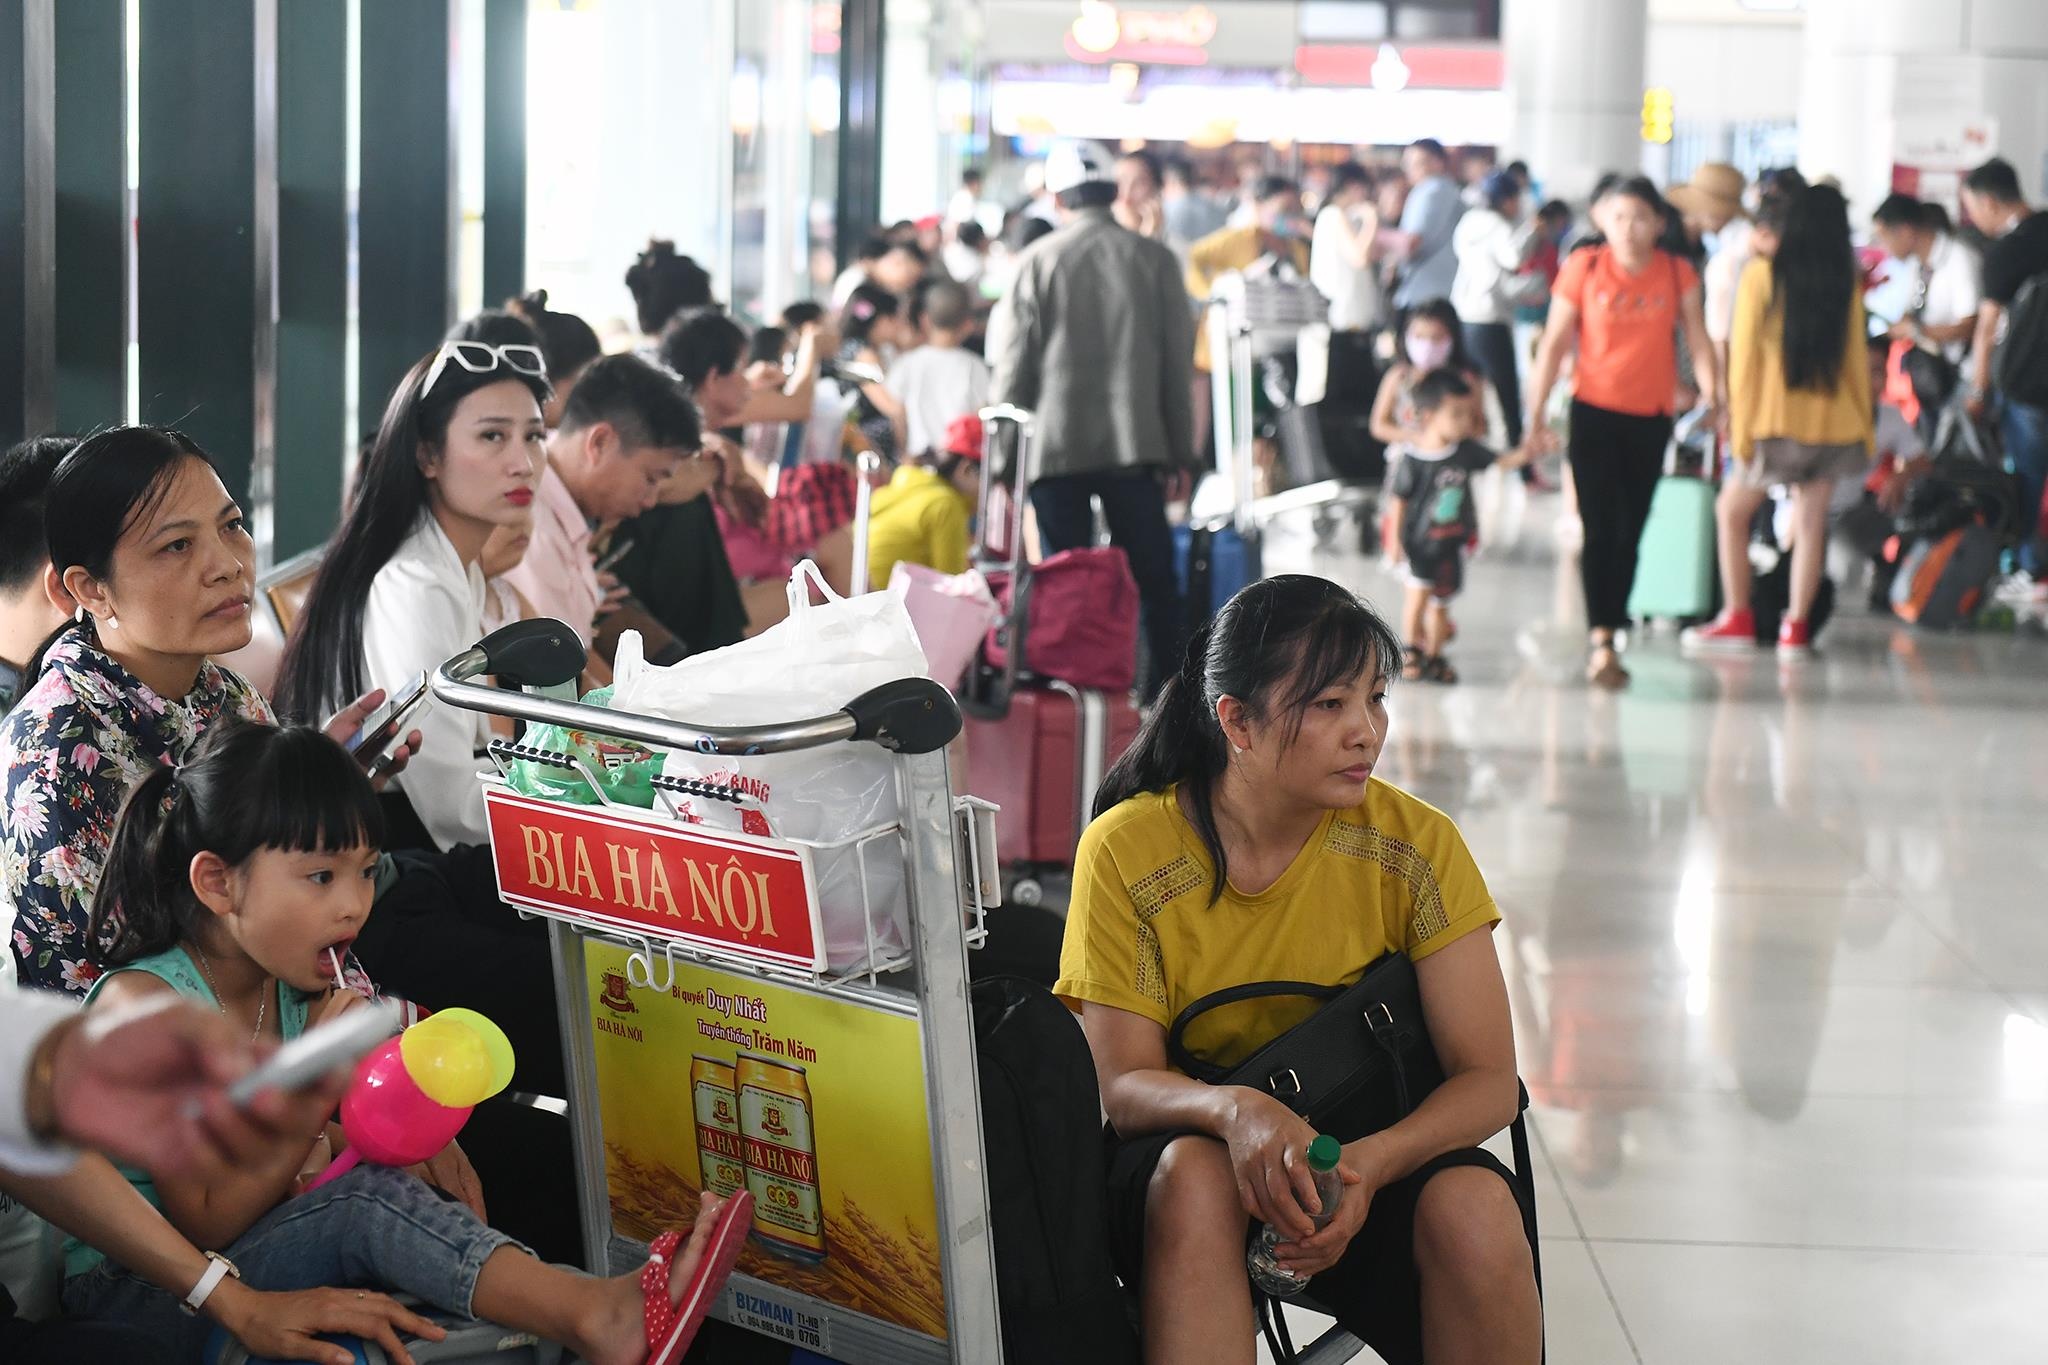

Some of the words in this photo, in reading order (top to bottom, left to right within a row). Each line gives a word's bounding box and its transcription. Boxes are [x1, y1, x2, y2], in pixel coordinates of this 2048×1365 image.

[519, 823, 604, 901] BIA
[605, 839, 682, 918] HÀ
[682, 855, 779, 940] NỘI
[682, 990, 705, 1006] quyết
[706, 987, 732, 1018] Duy
[734, 994, 767, 1024] Nhất
[597, 1017, 612, 1033] BIA
[726, 1026, 752, 1050] thống
[753, 1029, 784, 1056] Trăm
[787, 1038, 817, 1063] Năm
[745, 1141, 764, 1167] BIA
[766, 1147, 789, 1174] HÀ
[791, 1155, 814, 1182] NỘI
[736, 1291, 793, 1326] BIZMAN
[799, 1329, 820, 1347] 0709
